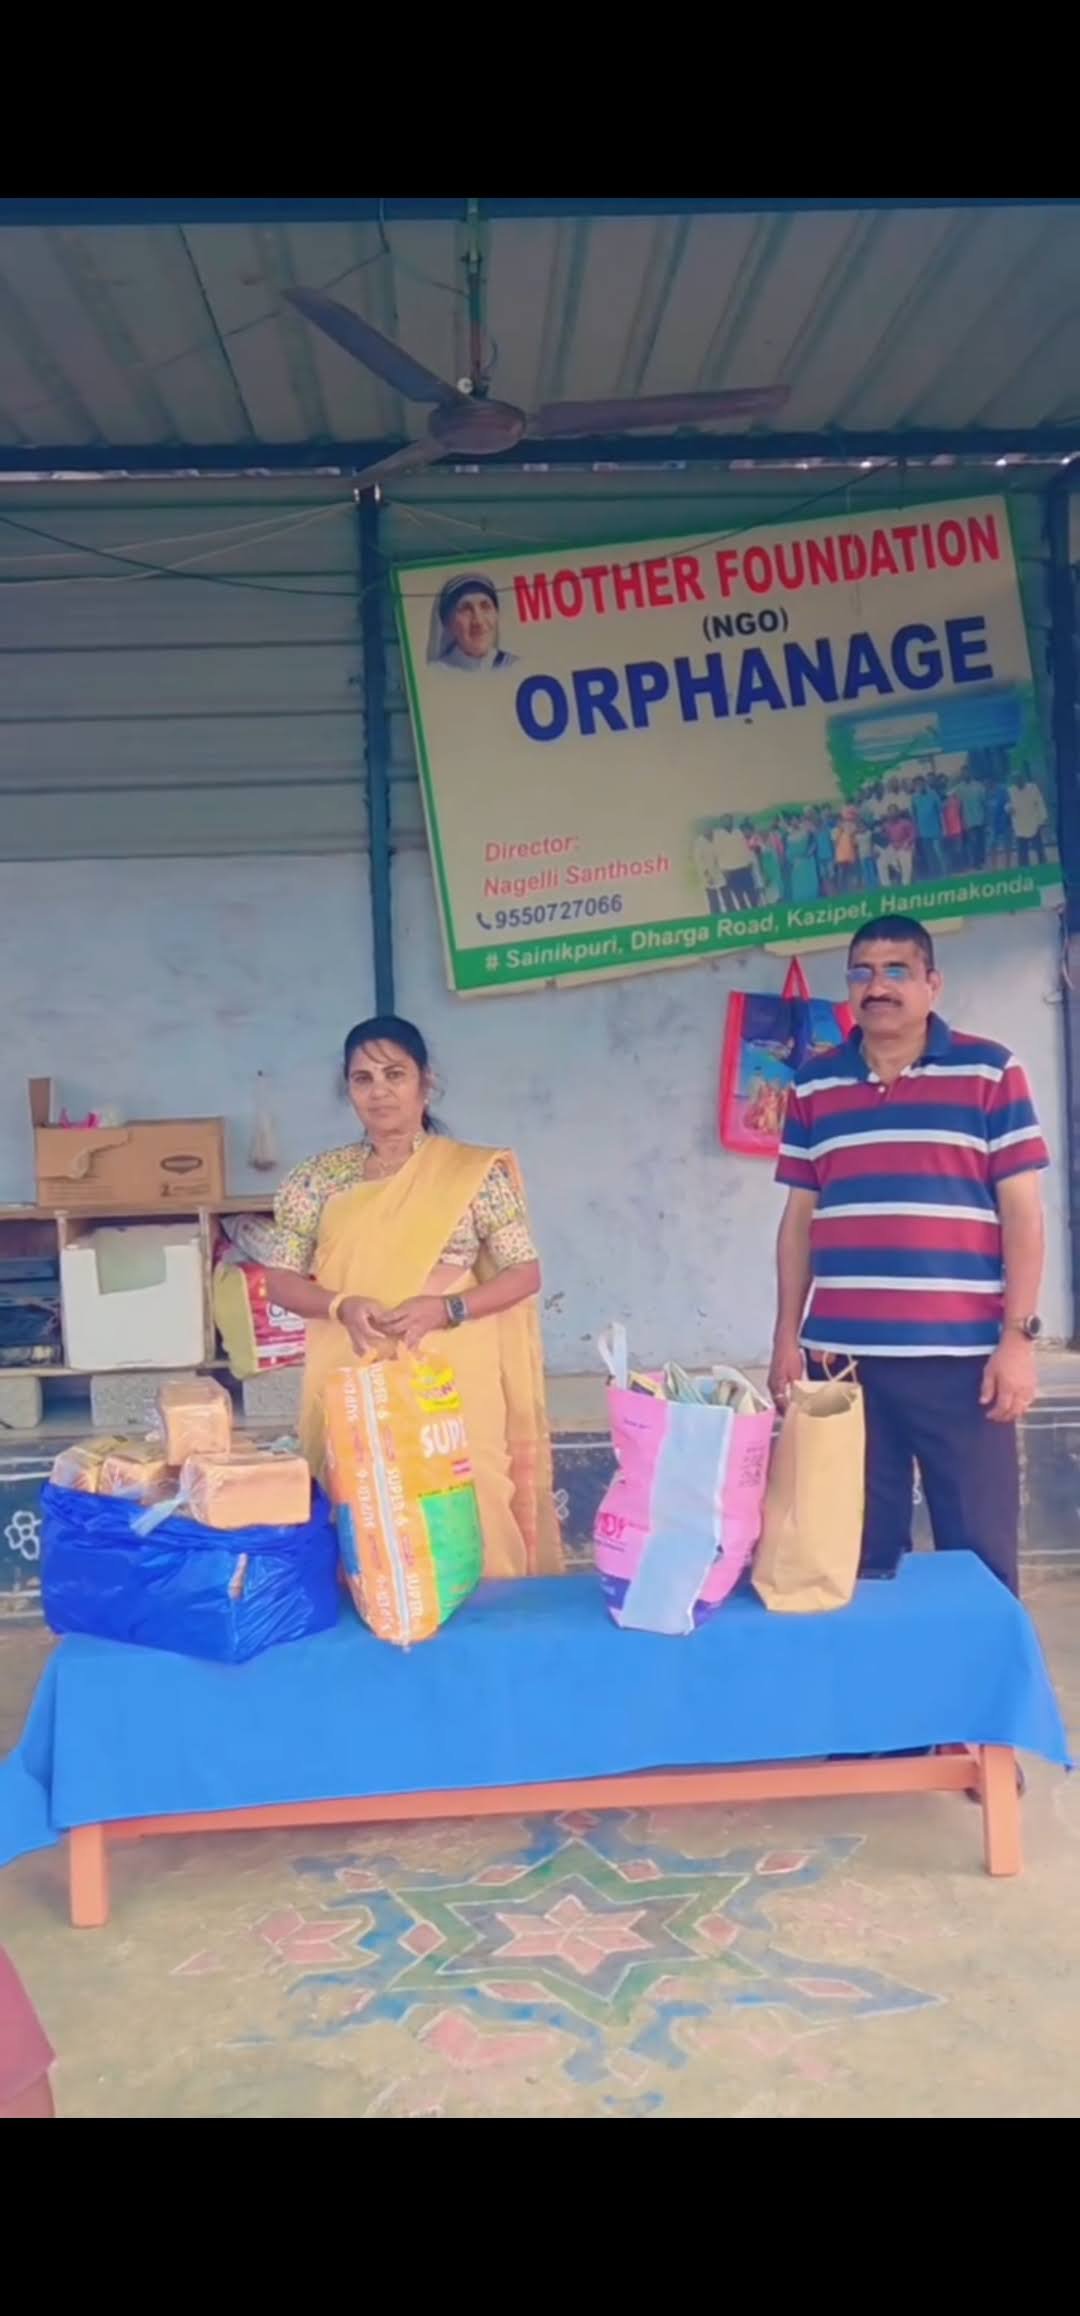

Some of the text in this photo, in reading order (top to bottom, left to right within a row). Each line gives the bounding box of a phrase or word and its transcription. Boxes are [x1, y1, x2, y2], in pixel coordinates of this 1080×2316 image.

[513, 514, 1000, 623] MOTHER FOUNDATION
[702, 606, 790, 643] (NGO)
[515, 615, 994, 742] ORPHANAGE
[484, 836, 580, 864] Director:
[483, 854, 671, 898] Nagelli Santhosh
[485, 875, 1036, 972] # Sainikpuri, Dharga Road, Kazipet, Hanumakonda
[495, 894, 624, 929] 9550727066
